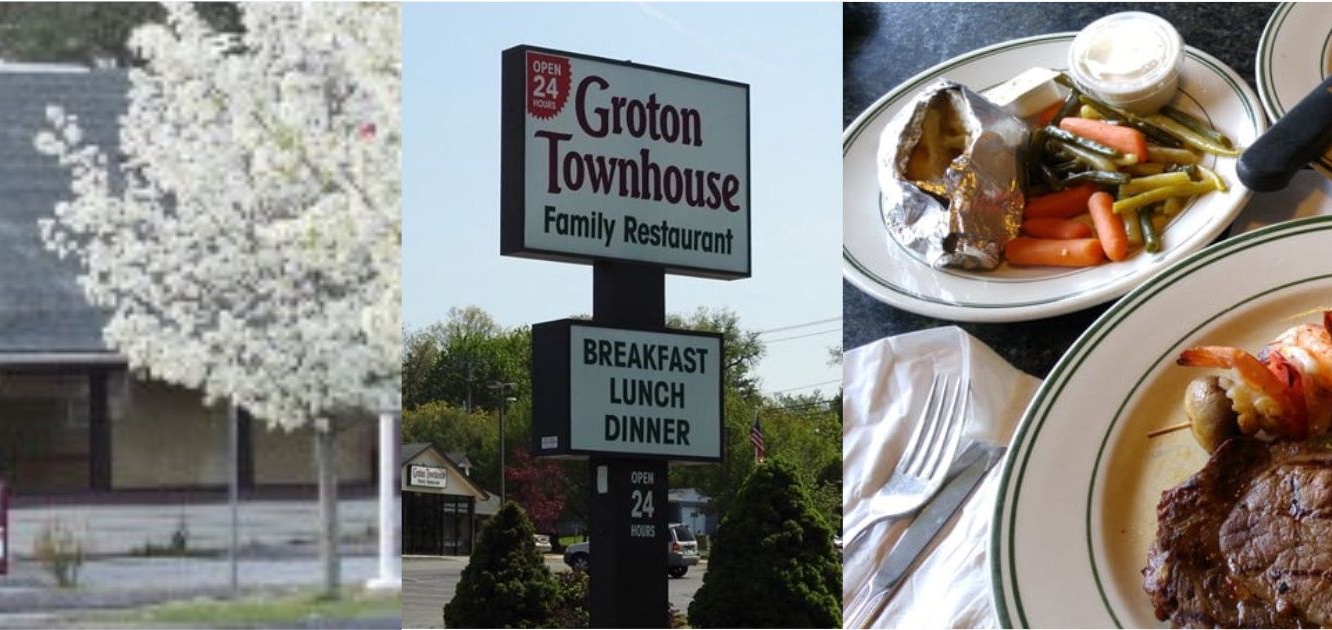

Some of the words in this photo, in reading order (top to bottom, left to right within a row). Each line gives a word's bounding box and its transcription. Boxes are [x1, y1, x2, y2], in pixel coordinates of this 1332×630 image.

[533, 60, 561, 76] OPEN
[533, 76, 559, 99] 24
[533, 99, 556, 110] HOURS
[575, 75, 702, 147] Groton
[534, 130, 740, 212] Townhouse
[544, 205, 616, 248] Family
[623, 215, 733, 255] Restaurant
[583, 338, 708, 374] BREAKFAST
[610, 377, 685, 409] LUNCH
[604, 414, 690, 446] DINNER
[631, 471, 654, 485] OPEN
[631, 490, 654, 518] 24
[630, 524, 655, 538] HOURS
